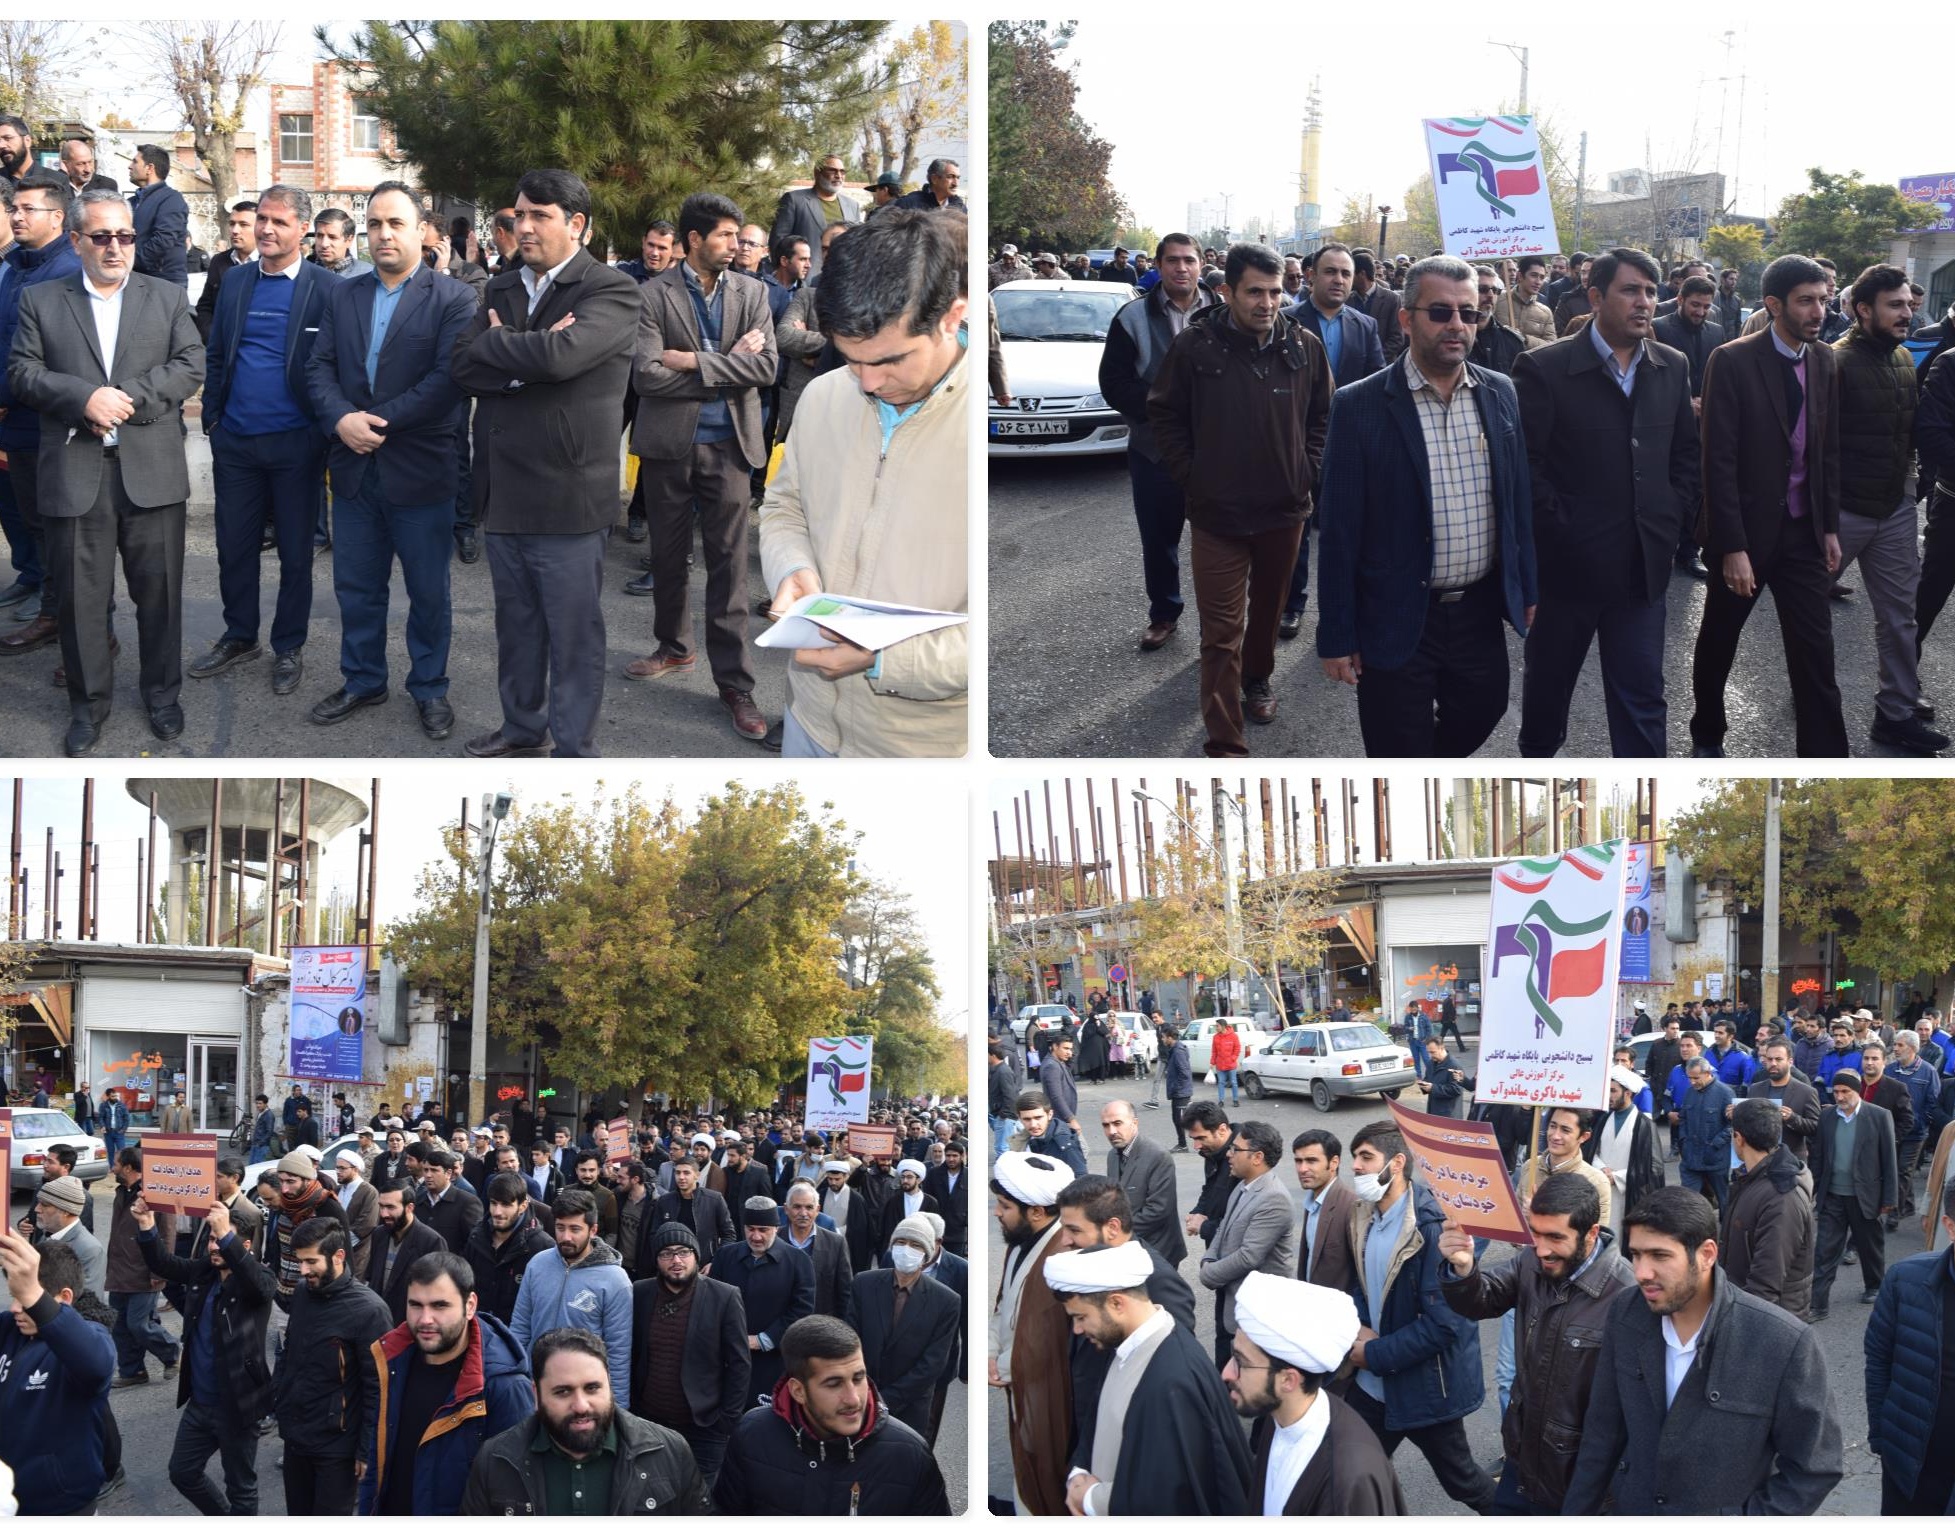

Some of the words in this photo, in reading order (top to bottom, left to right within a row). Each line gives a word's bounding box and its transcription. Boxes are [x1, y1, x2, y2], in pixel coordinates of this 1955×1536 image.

[1449, 227, 1468, 236] کاظمی
[1485, 225, 1500, 233] پایگاه
[1503, 224, 1530, 233] دانشجویی
[1500, 245, 1523, 256] باکری
[1525, 244, 1543, 252] شهید
[1404, 963, 1458, 986] فتوکپی
[1485, 1048, 1506, 1062] کاظمی
[1506, 1051, 1520, 1062] شهید
[1521, 1050, 1539, 1063] پایگاه
[1541, 1050, 1574, 1064] دانشجویی
[1575, 1053, 1593, 1064] بسیج
[102, 1050, 163, 1075] فتوکپی
[1509, 1069, 1524, 1079] عالی
[1525, 1068, 1547, 1081] آموزش
[1549, 1070, 1565, 1081] مرکز
[1530, 1085, 1557, 1101] باکری
[1559, 1088, 1582, 1102] شهید
[163, 1165, 177, 1175] ایجاد
[179, 1167, 185, 1177] از
[186, 1166, 202, 1176] هدف
[192, 1184, 210, 1197] گمراه
